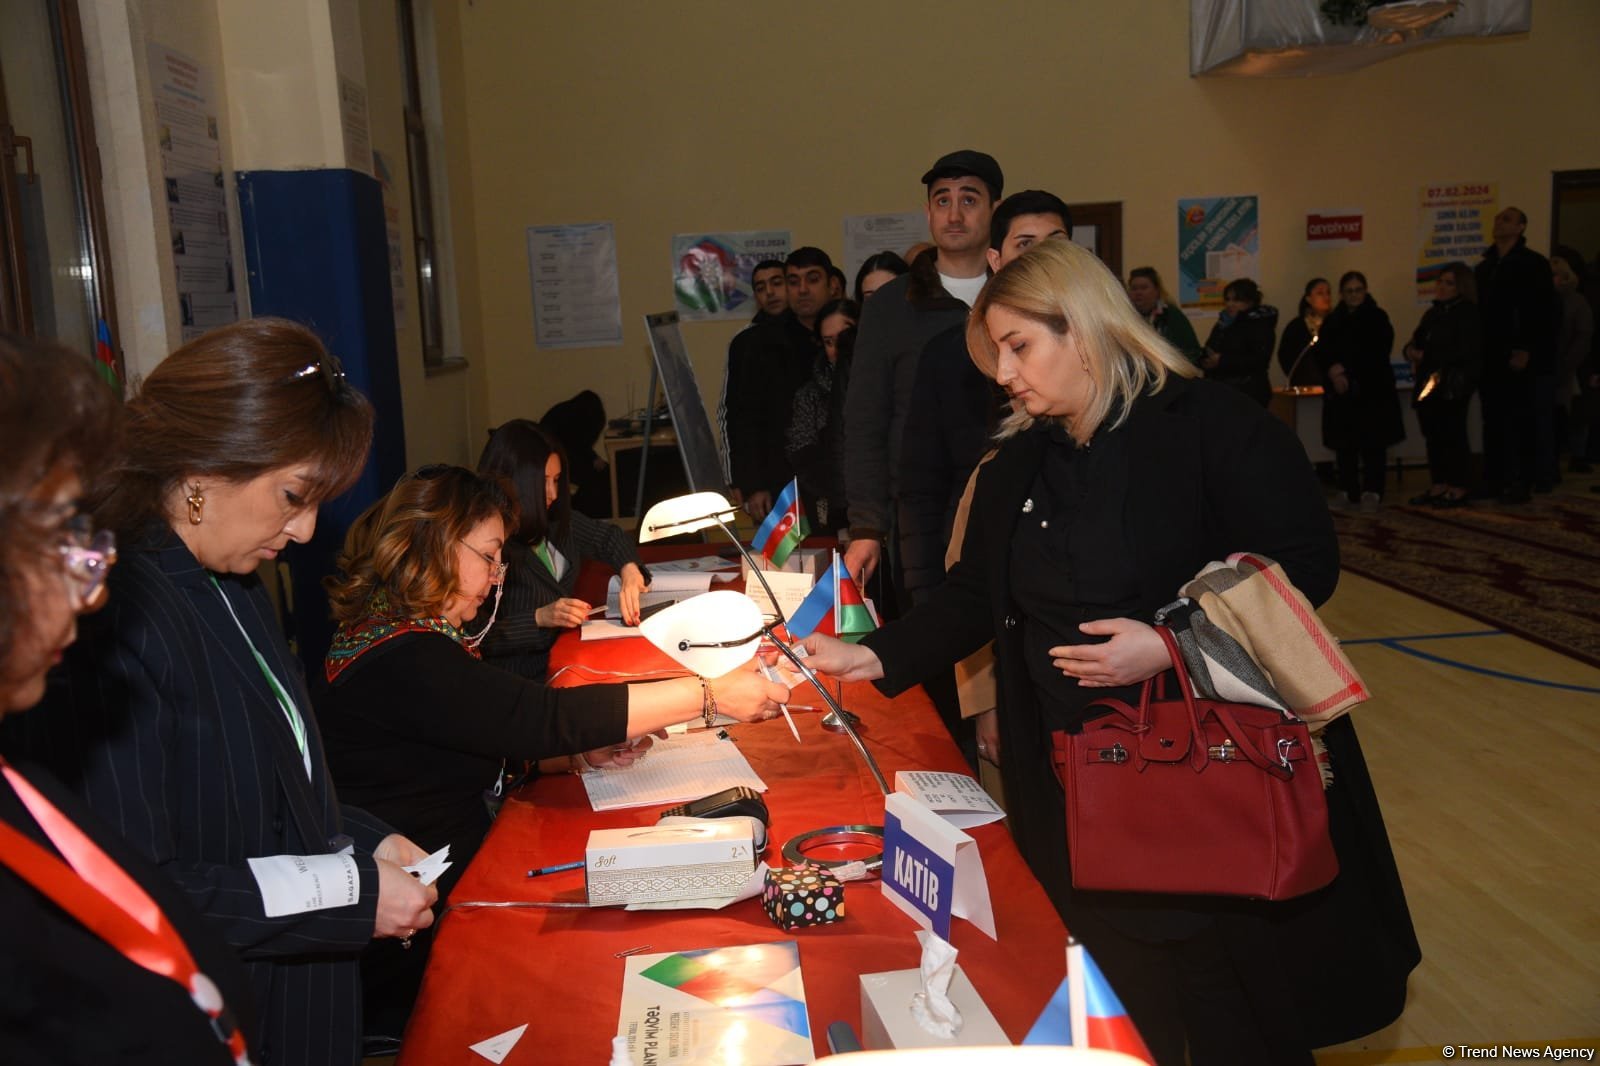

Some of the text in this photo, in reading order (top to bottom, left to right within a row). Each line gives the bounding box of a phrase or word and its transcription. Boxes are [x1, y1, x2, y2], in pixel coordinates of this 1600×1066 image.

[595, 855, 617, 868] Soft
[894, 846, 939, 912] KATİB
[644, 1005, 663, 1040] TƏQVİM
